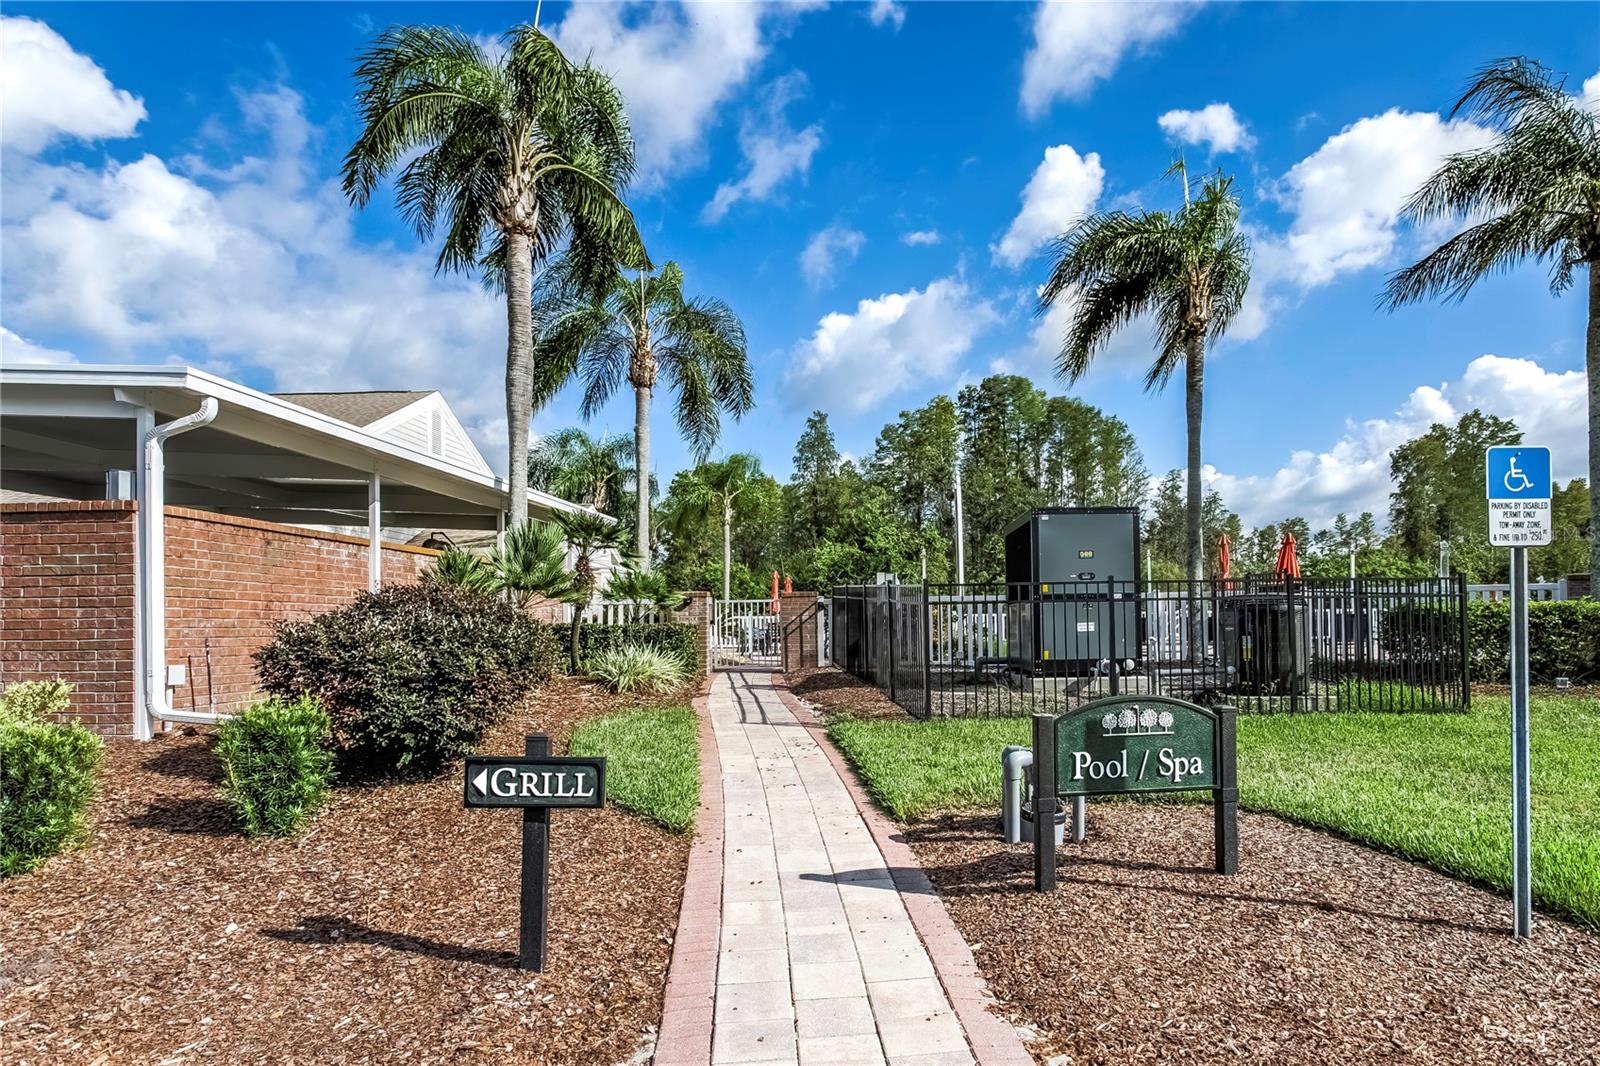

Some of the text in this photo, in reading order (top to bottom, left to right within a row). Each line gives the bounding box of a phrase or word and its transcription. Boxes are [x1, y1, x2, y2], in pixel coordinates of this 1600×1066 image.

[1491, 502, 1548, 510] PARKING BY DISABLED
[1499, 521, 1525, 529] TOW-AWAY
[1499, 533, 1510, 542] FINE
[1072, 747, 1204, 782] Pool / Spa
[490, 767, 595, 798] GRILL
